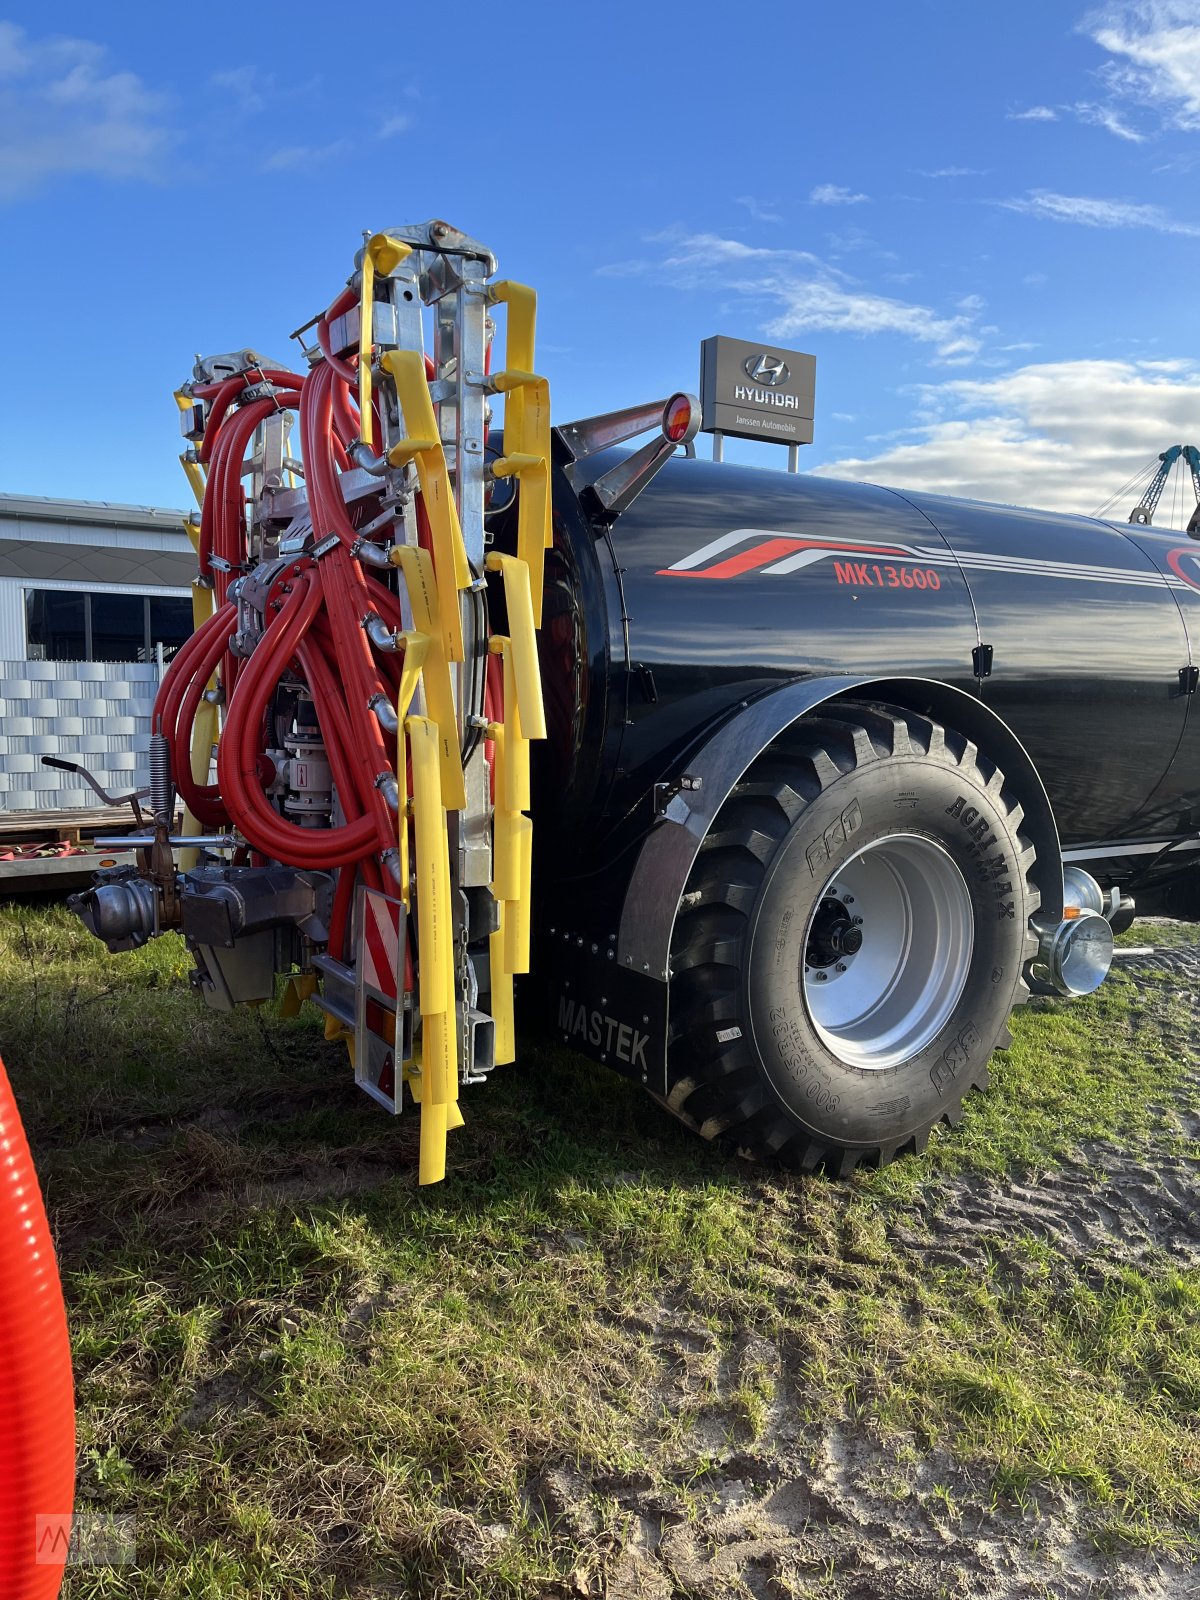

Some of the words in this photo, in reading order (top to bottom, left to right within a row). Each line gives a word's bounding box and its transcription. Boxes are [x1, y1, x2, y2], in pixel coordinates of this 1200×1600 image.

[735, 385, 799, 409] HYUNDAI
[735, 414, 760, 428] Janssen
[761, 419, 796, 433] Automobile
[833, 561, 941, 591] MK13600
[805, 797, 863, 879] BKT
[558, 995, 650, 1071] MASTEK
